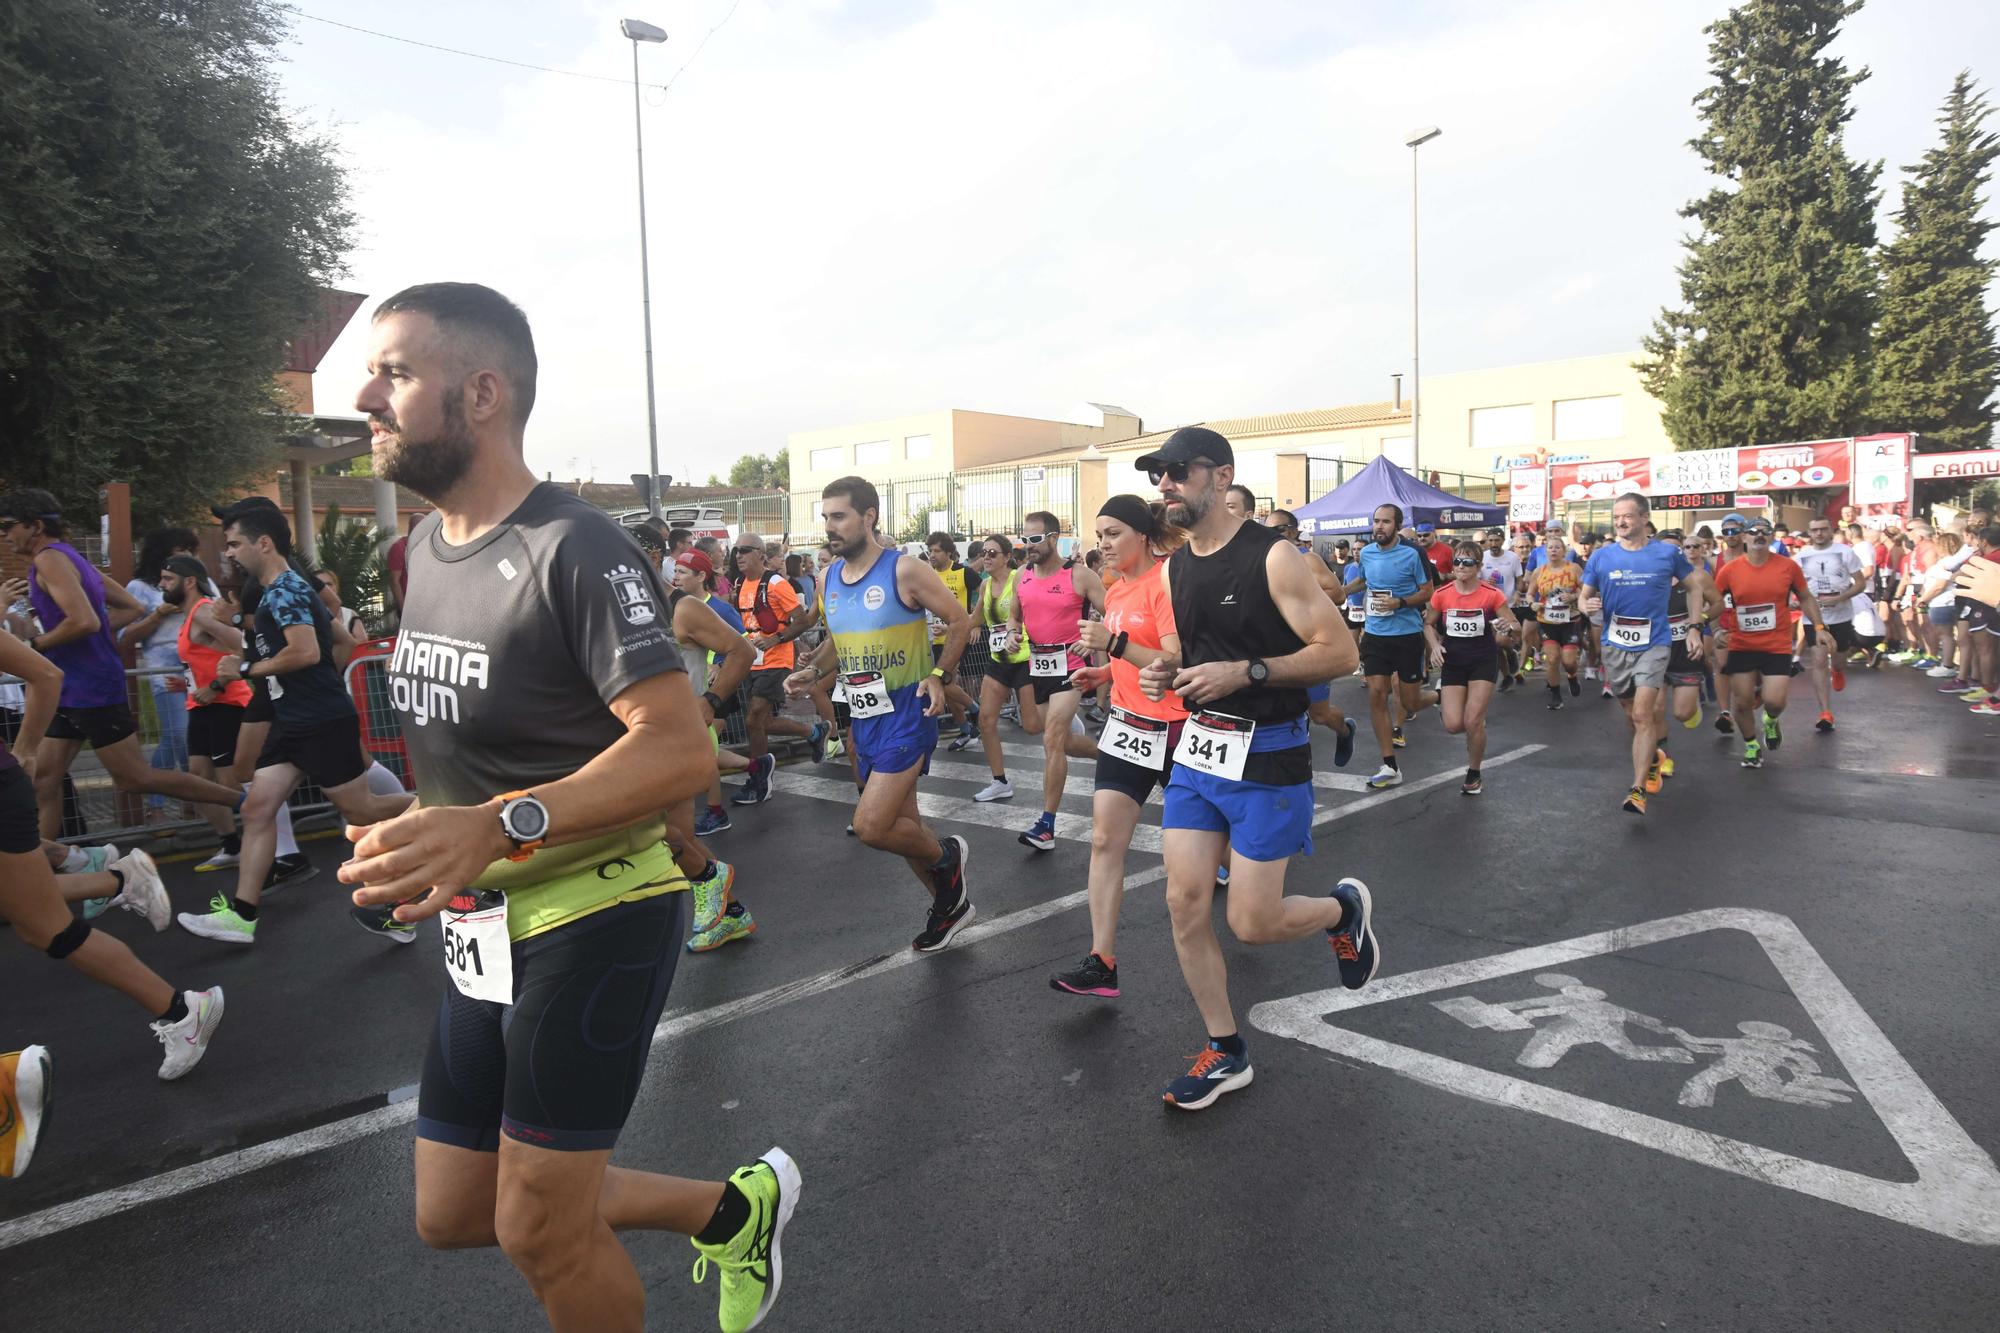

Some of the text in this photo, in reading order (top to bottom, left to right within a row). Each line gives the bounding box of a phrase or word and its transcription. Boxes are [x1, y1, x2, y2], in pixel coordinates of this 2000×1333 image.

[1875, 444, 1895, 456] AC
[1677, 451, 1731, 463] XXVIII
[1933, 459, 2000, 477] FAMU
[1548, 612, 1565, 620] 449
[1744, 616, 1769, 627] 584
[1454, 622, 1478, 632] 303
[1671, 625, 1687, 636] 83
[1615, 629, 1641, 642] 400
[850, 656, 860, 671] DE
[863, 650, 906, 671] BRUJAS
[1035, 659, 1058, 671] 591
[851, 692, 879, 709] 468
[1113, 732, 1152, 758] 245
[1188, 734, 1229, 765] 341
[1194, 761, 1213, 771] LOREN
[445, 926, 484, 976] 581
